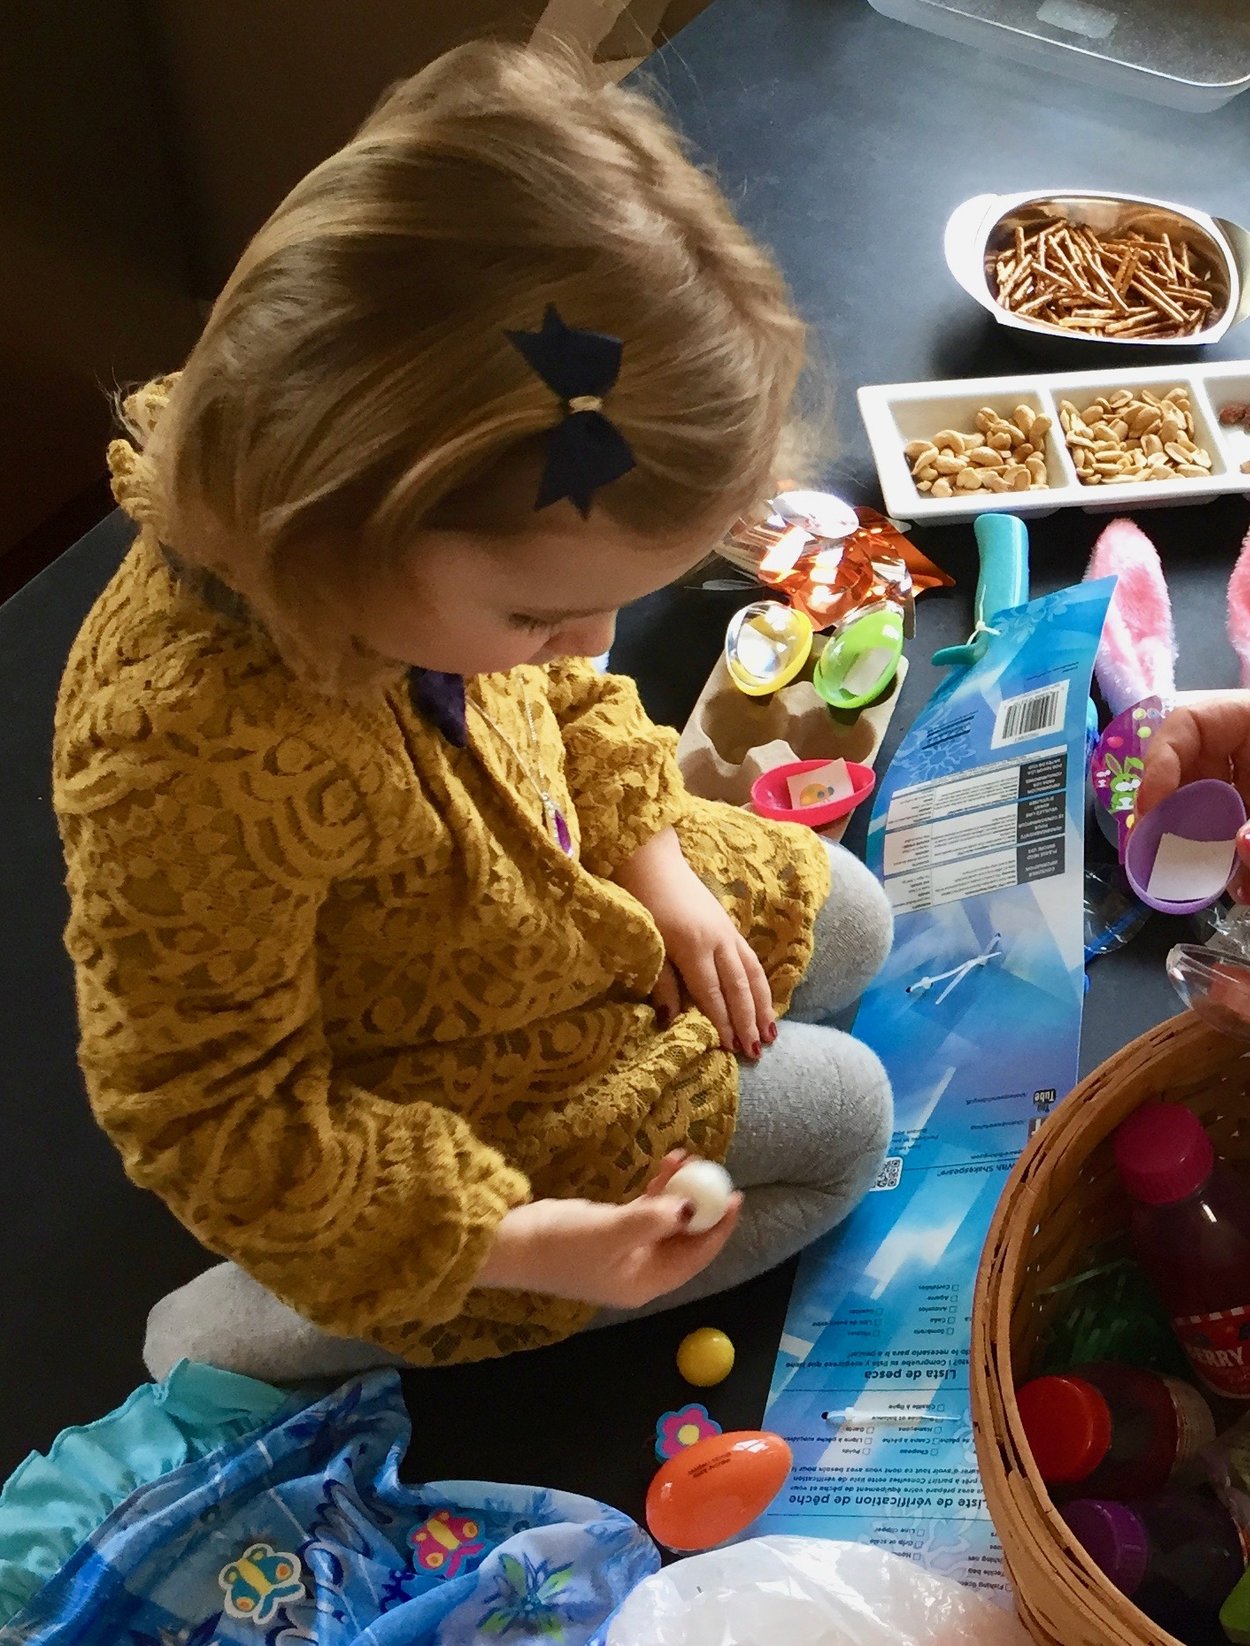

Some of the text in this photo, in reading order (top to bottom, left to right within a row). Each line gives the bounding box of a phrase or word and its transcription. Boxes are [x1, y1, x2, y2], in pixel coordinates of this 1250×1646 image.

[1035, 1090, 1055, 1102] Tube
[911, 1348, 949, 1357] necesario
[901, 1358, 946, 1367] Compruebe
[864, 1368, 956, 1380] Lista de pesca
[856, 1486, 900, 1494] équipement
[925, 1486, 955, 1494] préparé
[789, 1494, 829, 1505] pêche
[834, 1495, 851, 1505] de
[856, 1496, 932, 1507] vérification
[937, 1497, 953, 1507] de
[978, 1579, 1004, 1591] Fishing
